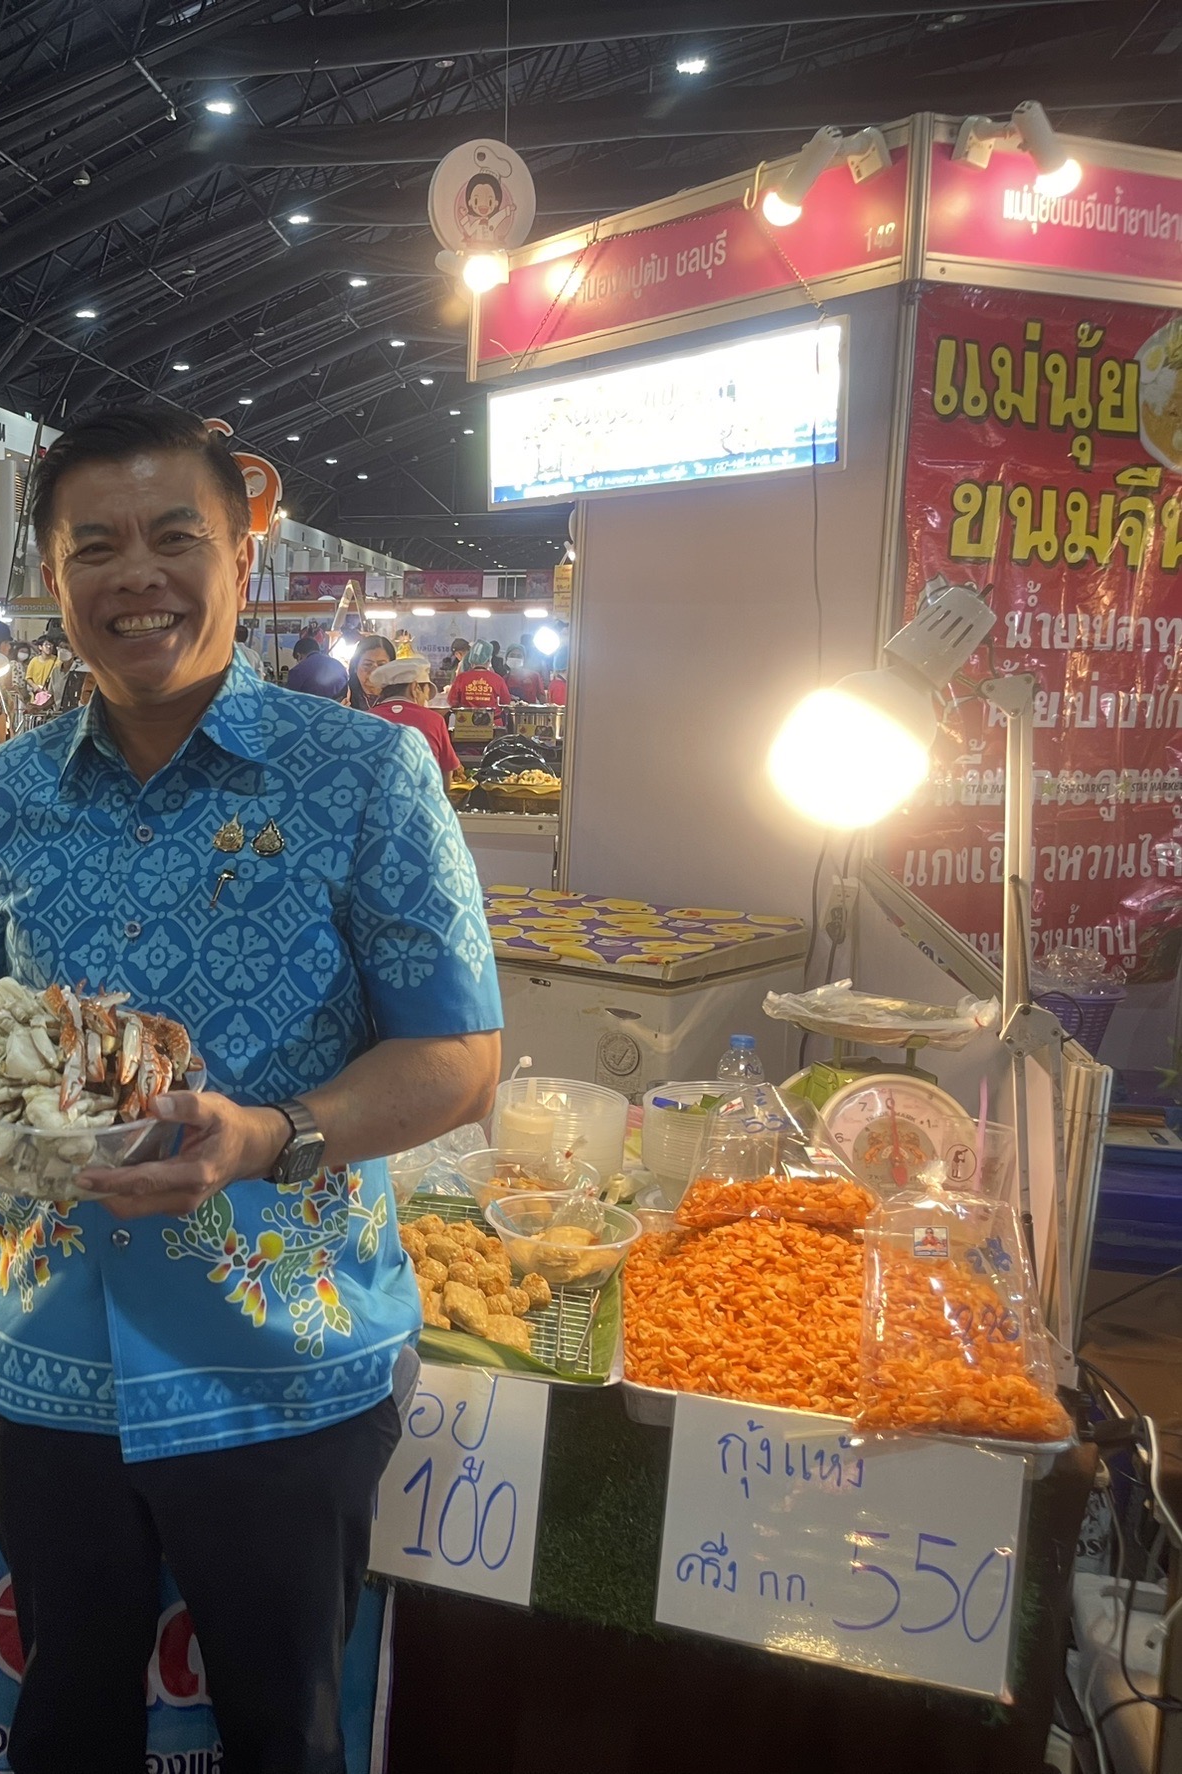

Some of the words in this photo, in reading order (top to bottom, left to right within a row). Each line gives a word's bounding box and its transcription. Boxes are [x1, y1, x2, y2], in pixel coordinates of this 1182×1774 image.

[676, 230, 728, 279] ชลบุรี
[933, 320, 1140, 467] แม่นุ้ย
[1131, 783, 1149, 793] STAR
[718, 1420, 865, 1499] กุ้งแห้ง
[402, 1457, 517, 1570] 100
[760, 1571, 815, 1608] กก.
[832, 1531, 1012, 1643] 550
